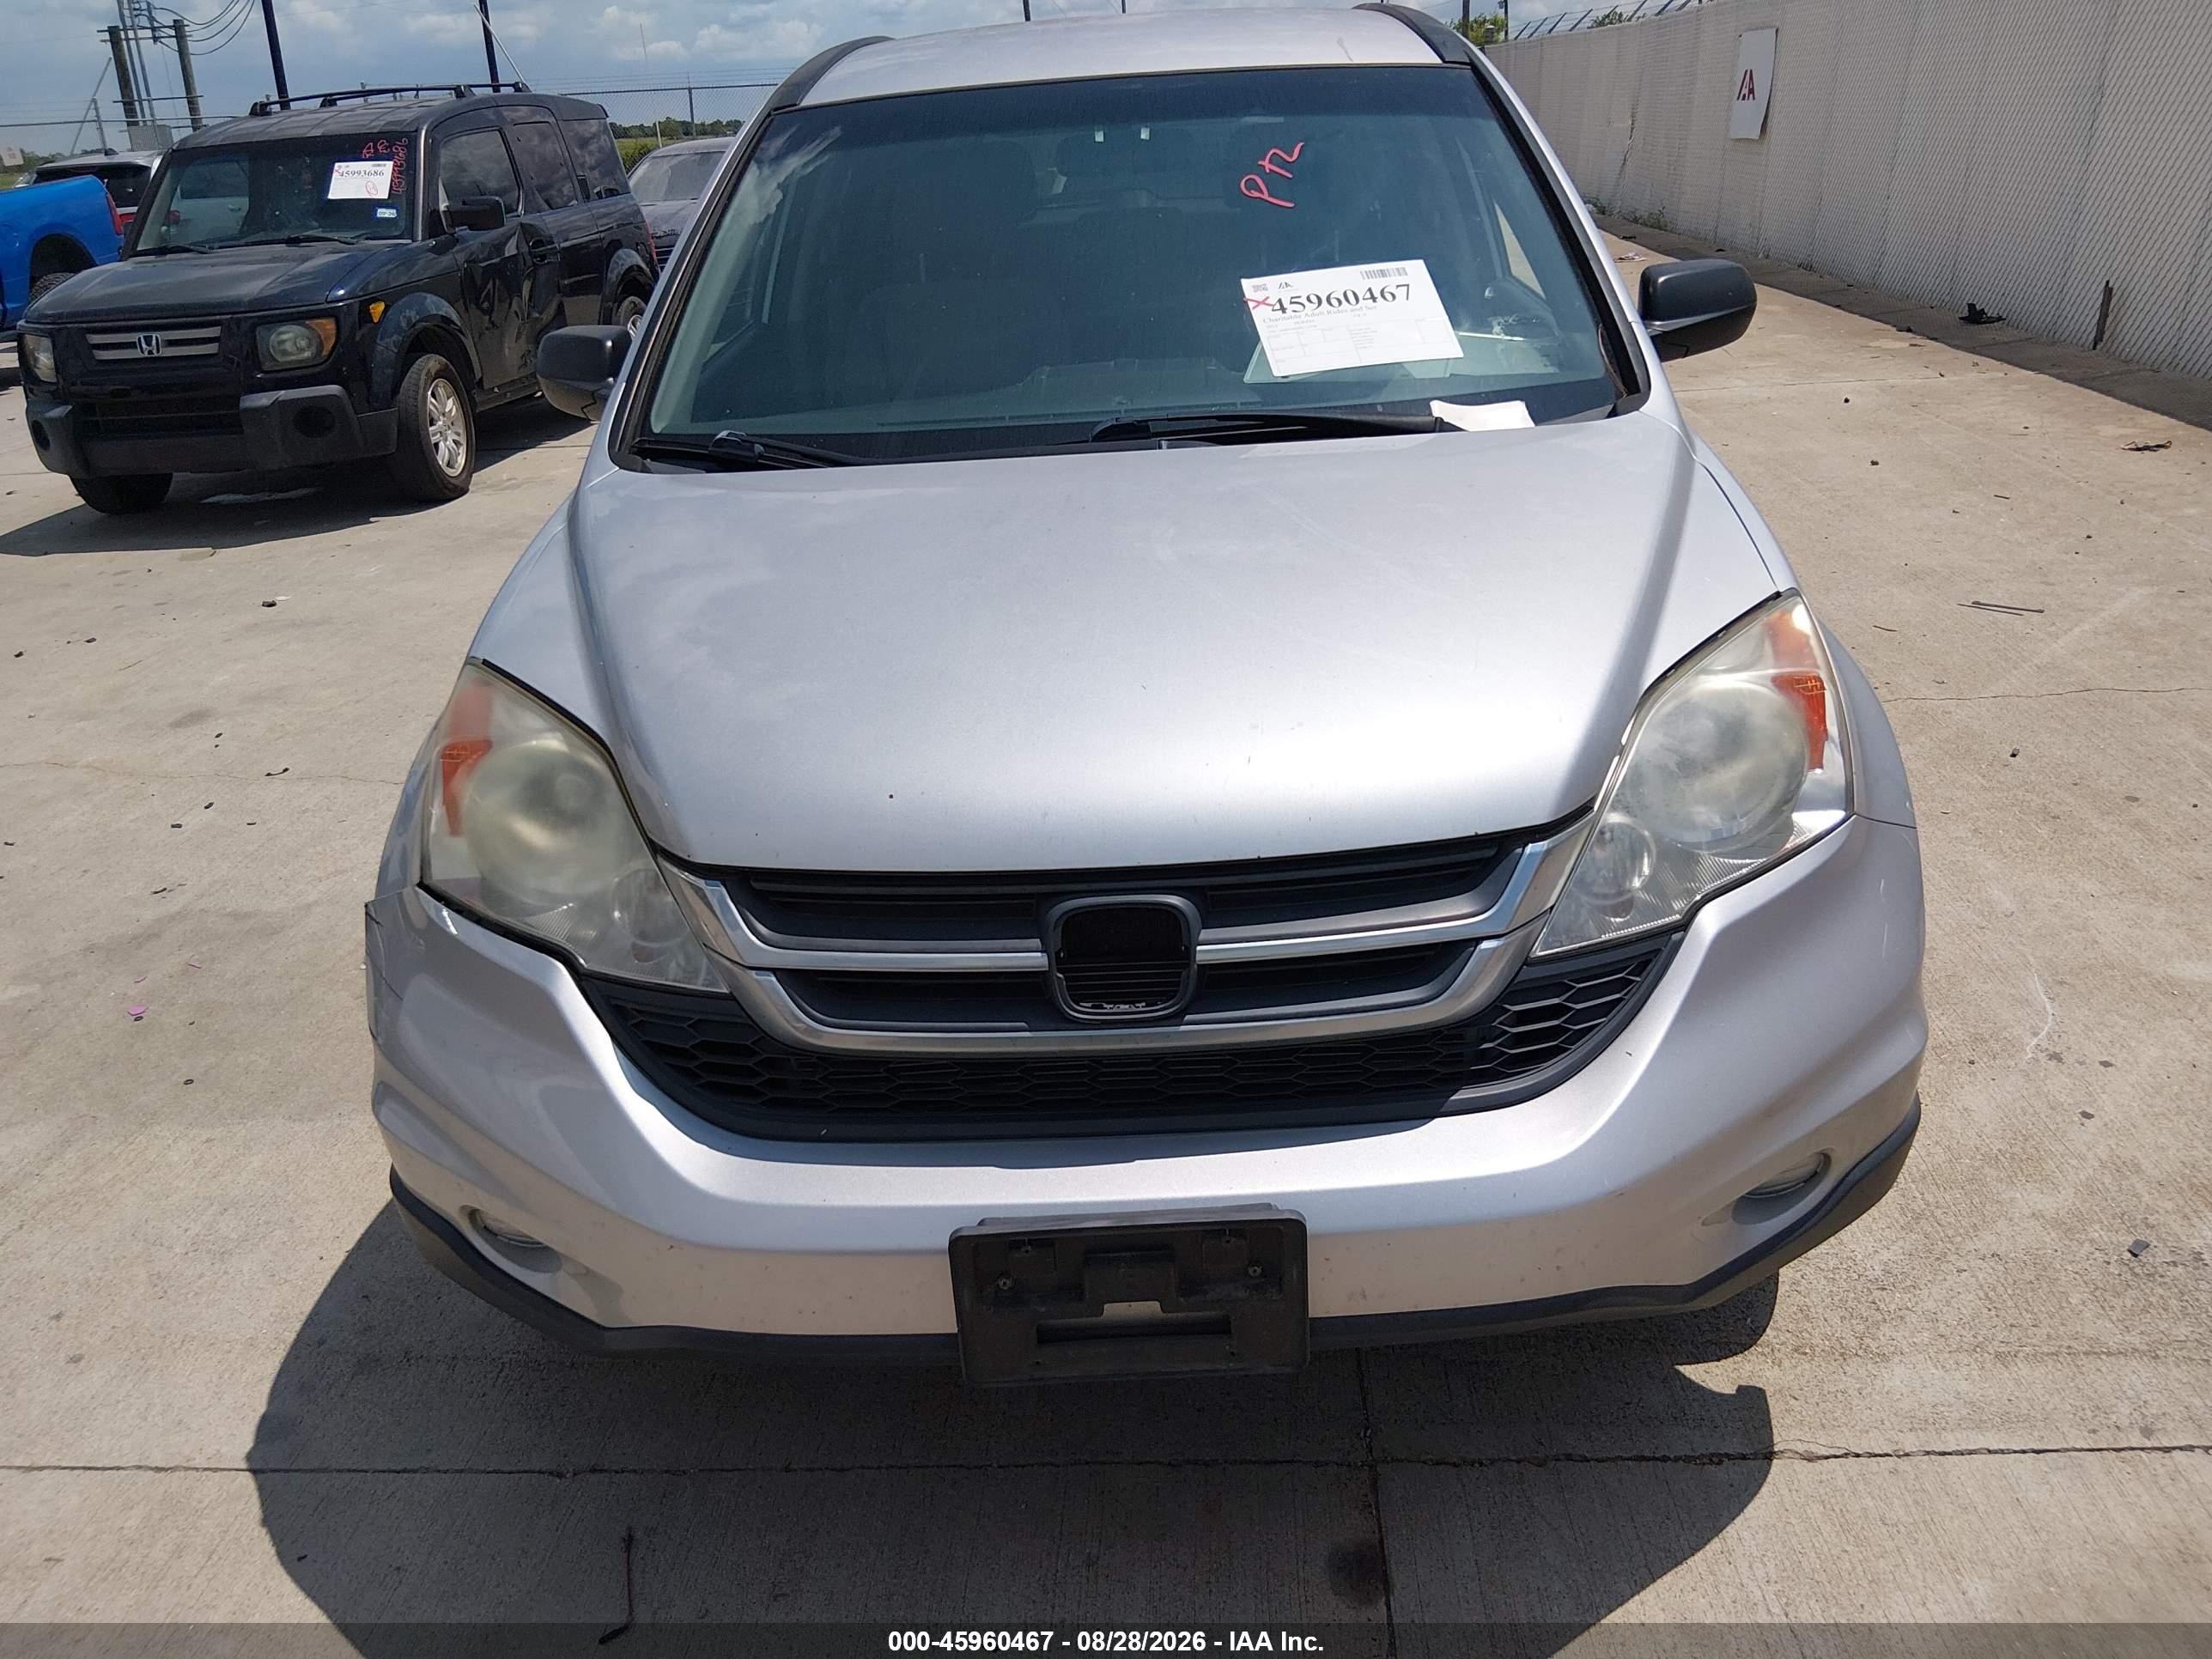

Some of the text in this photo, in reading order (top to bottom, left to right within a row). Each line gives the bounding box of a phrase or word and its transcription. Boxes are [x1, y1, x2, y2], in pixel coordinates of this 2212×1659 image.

[340, 169, 385, 178] 45993686
[1271, 283, 1410, 314] 45960467
[1262, 313, 1302, 324] Charitable
[1304, 309, 1325, 319] Adult
